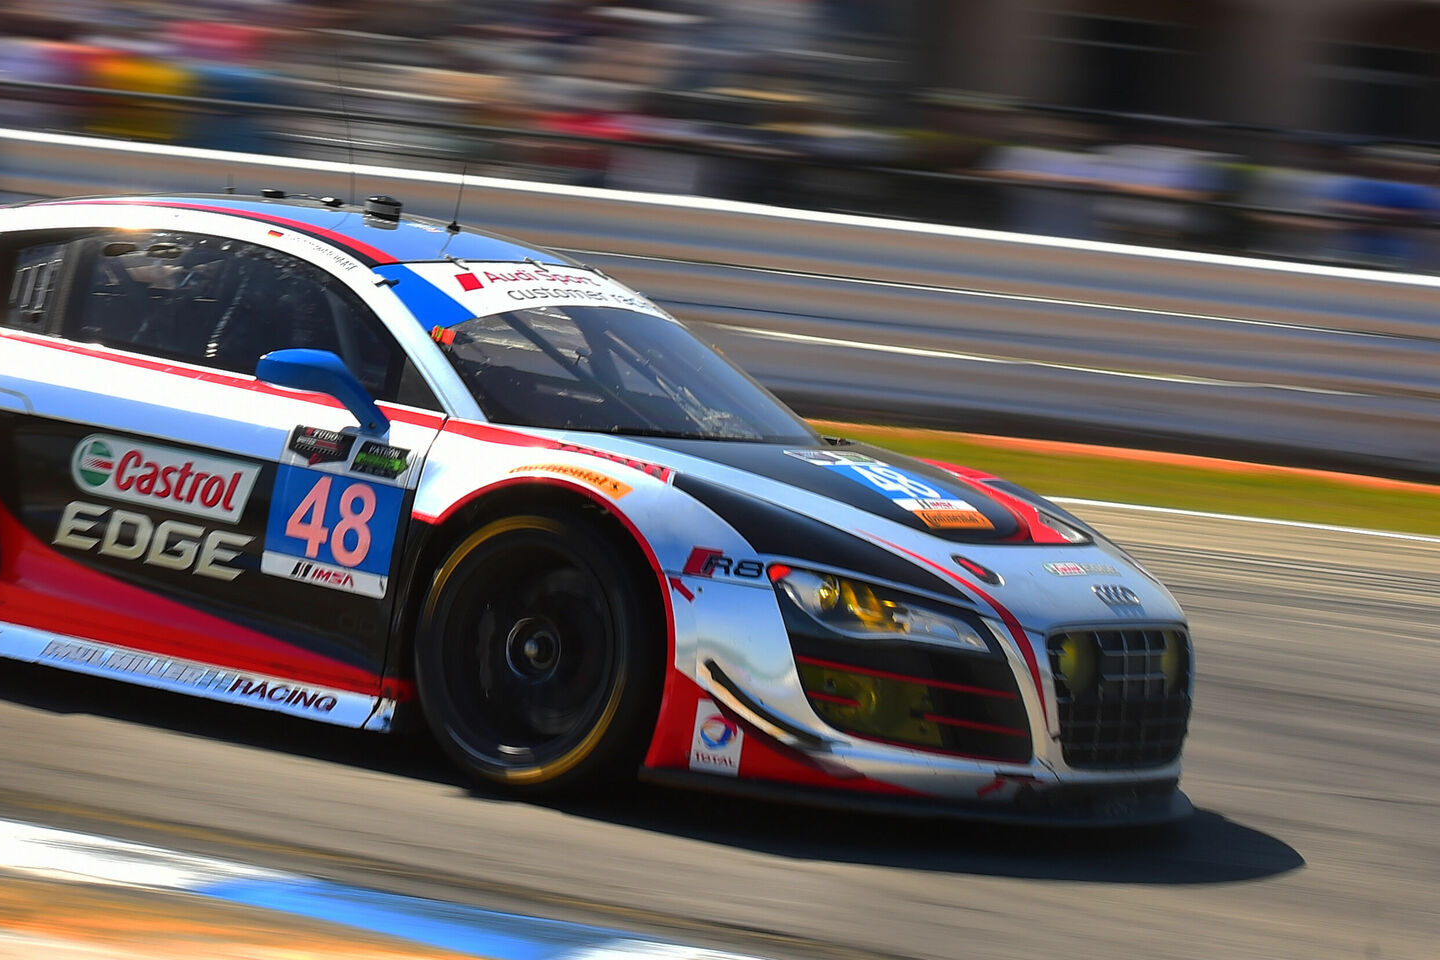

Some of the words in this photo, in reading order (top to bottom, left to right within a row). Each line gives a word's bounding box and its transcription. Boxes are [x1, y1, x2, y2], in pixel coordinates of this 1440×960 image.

[483, 270, 539, 283] Audi
[534, 270, 600, 286] Sport
[506, 287, 608, 301] customer
[115, 450, 244, 512] Castrol
[285, 475, 377, 568] 48
[52, 500, 257, 581] EDGE
[310, 567, 355, 589] IMSA
[701, 554, 764, 578] R8
[228, 677, 338, 712] RACING
